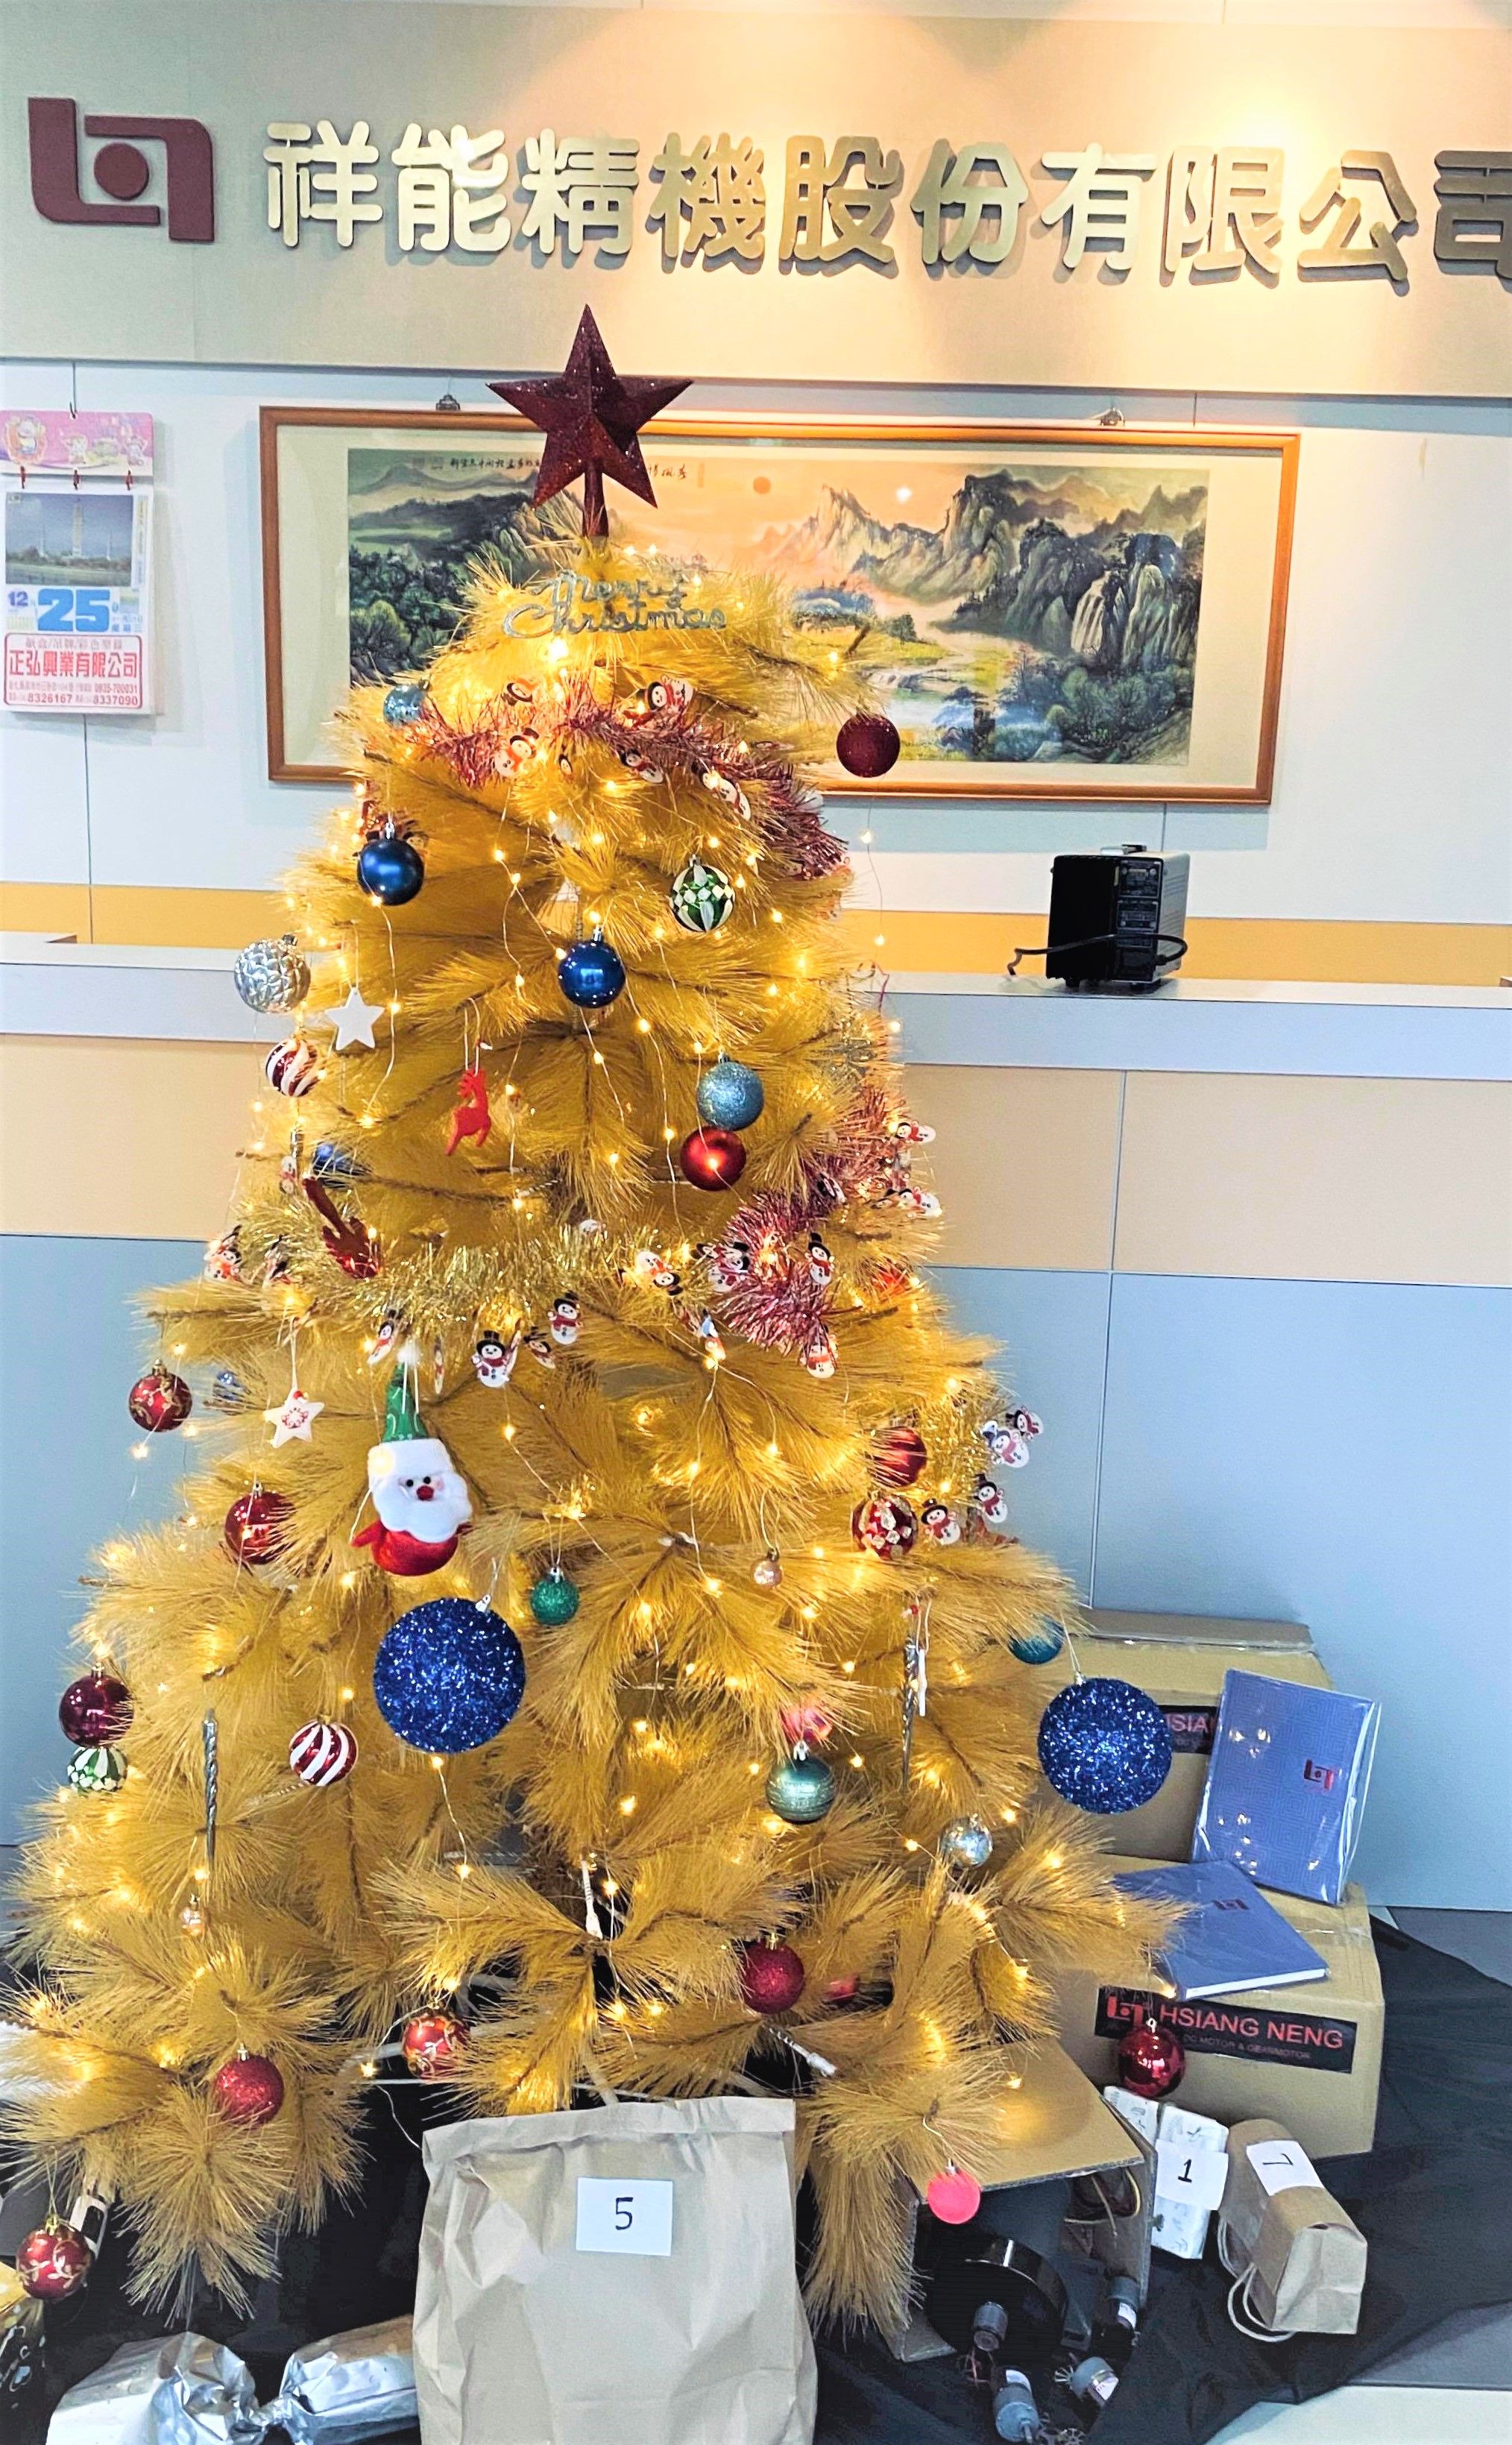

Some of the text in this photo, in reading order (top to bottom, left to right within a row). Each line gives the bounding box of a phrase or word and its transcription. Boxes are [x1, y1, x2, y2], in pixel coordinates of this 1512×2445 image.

[262, 119, 1512, 282] 祥能精機股份有限公司
[8, 591, 28, 606] 12
[38, 589, 110, 632] 25
[503, 600, 728, 638] Christmas
[9, 649, 138, 678] 正弘興業有限公司
[1160, 2004, 1343, 2049] HSIANG NENG
[1199, 2036, 1235, 2048] MOTOR
[1177, 2159, 1192, 2183] 1
[615, 2197, 634, 2230] 5
